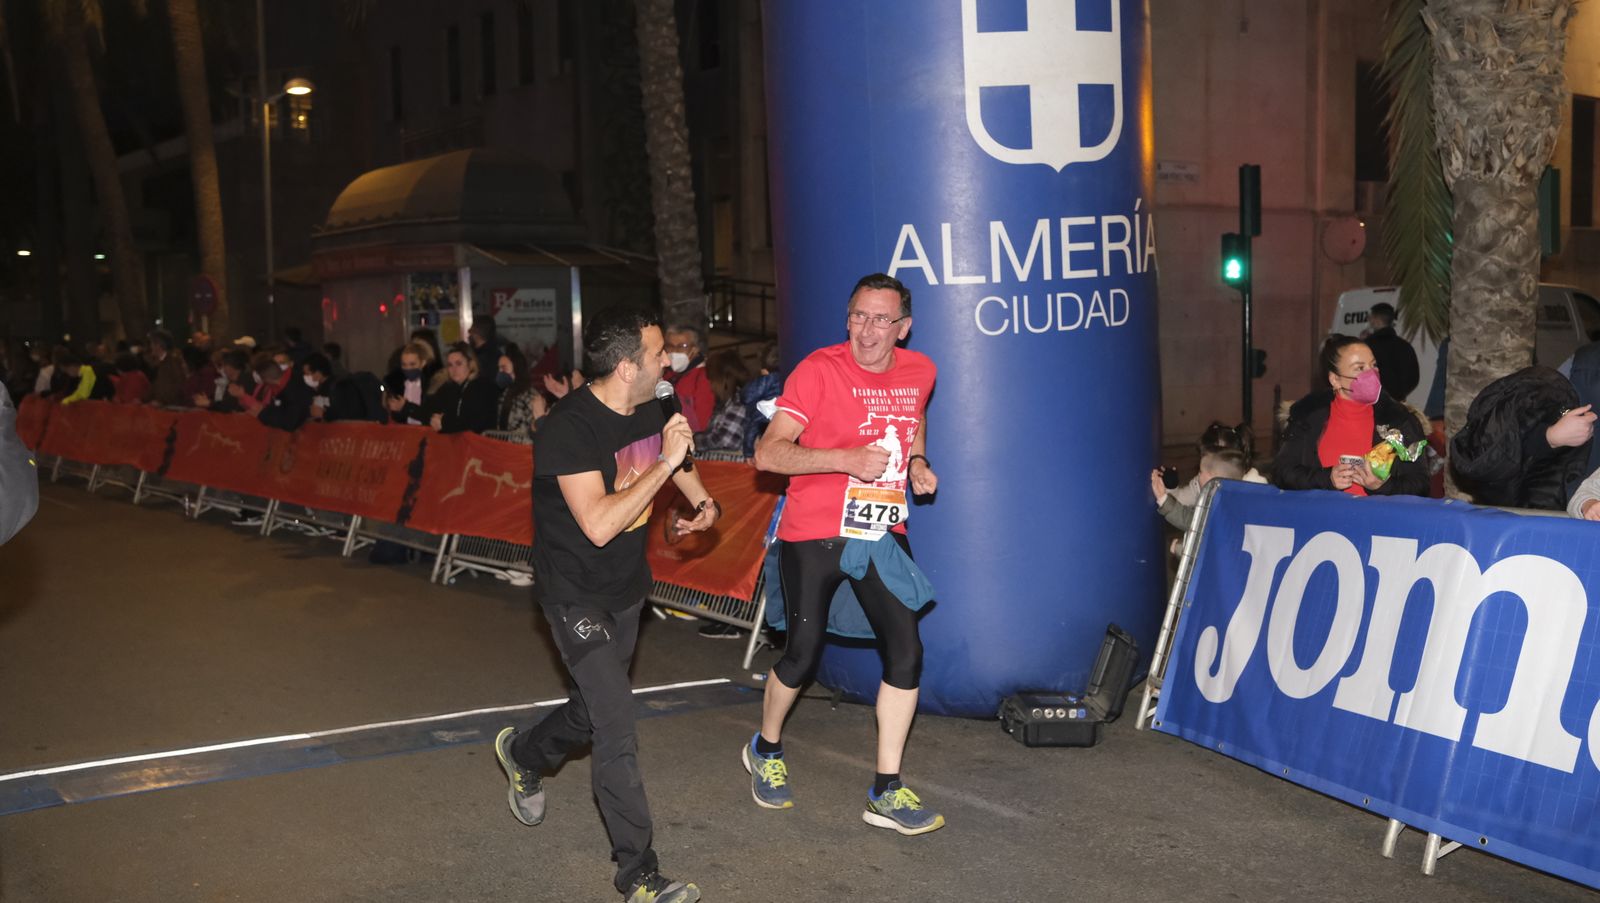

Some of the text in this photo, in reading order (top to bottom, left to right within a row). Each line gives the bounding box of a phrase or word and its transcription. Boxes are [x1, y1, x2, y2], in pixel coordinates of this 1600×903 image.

[887, 198, 1158, 286] ALMERÍA
[974, 289, 1130, 337] CIUDAD
[858, 503, 900, 524] 478
[1195, 524, 1600, 774] Jom
